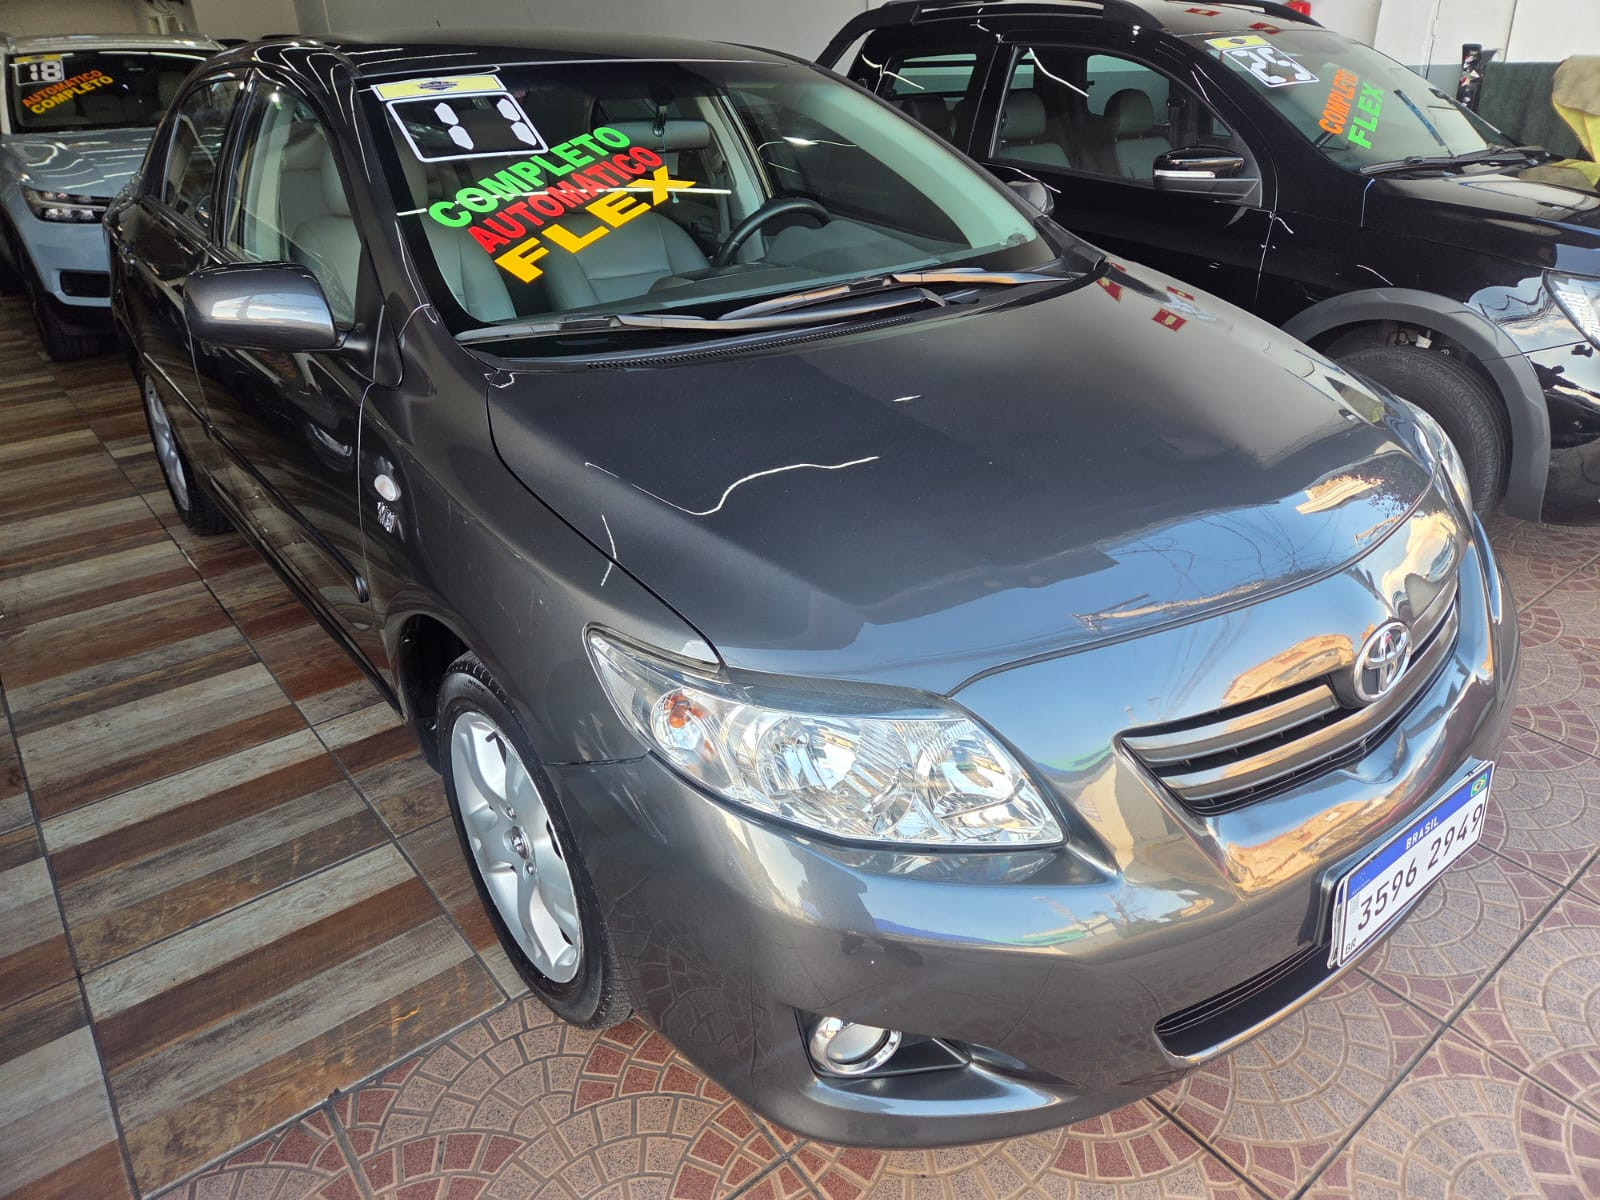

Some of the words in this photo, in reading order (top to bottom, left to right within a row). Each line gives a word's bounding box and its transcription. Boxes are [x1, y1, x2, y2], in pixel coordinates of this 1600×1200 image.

[22, 70, 103, 108] AUTOMATICO
[29, 61, 61, 81] 18
[30, 75, 113, 115] COMPLETO
[1347, 82, 1385, 149] FLEX
[428, 126, 631, 228] COMPLETO
[467, 146, 663, 254] AUTOMATICO
[494, 165, 697, 284] FLEX
[1405, 815, 1440, 850] BRASIL
[1357, 858, 1417, 931] 3596
[1427, 803, 1484, 871] 2949
